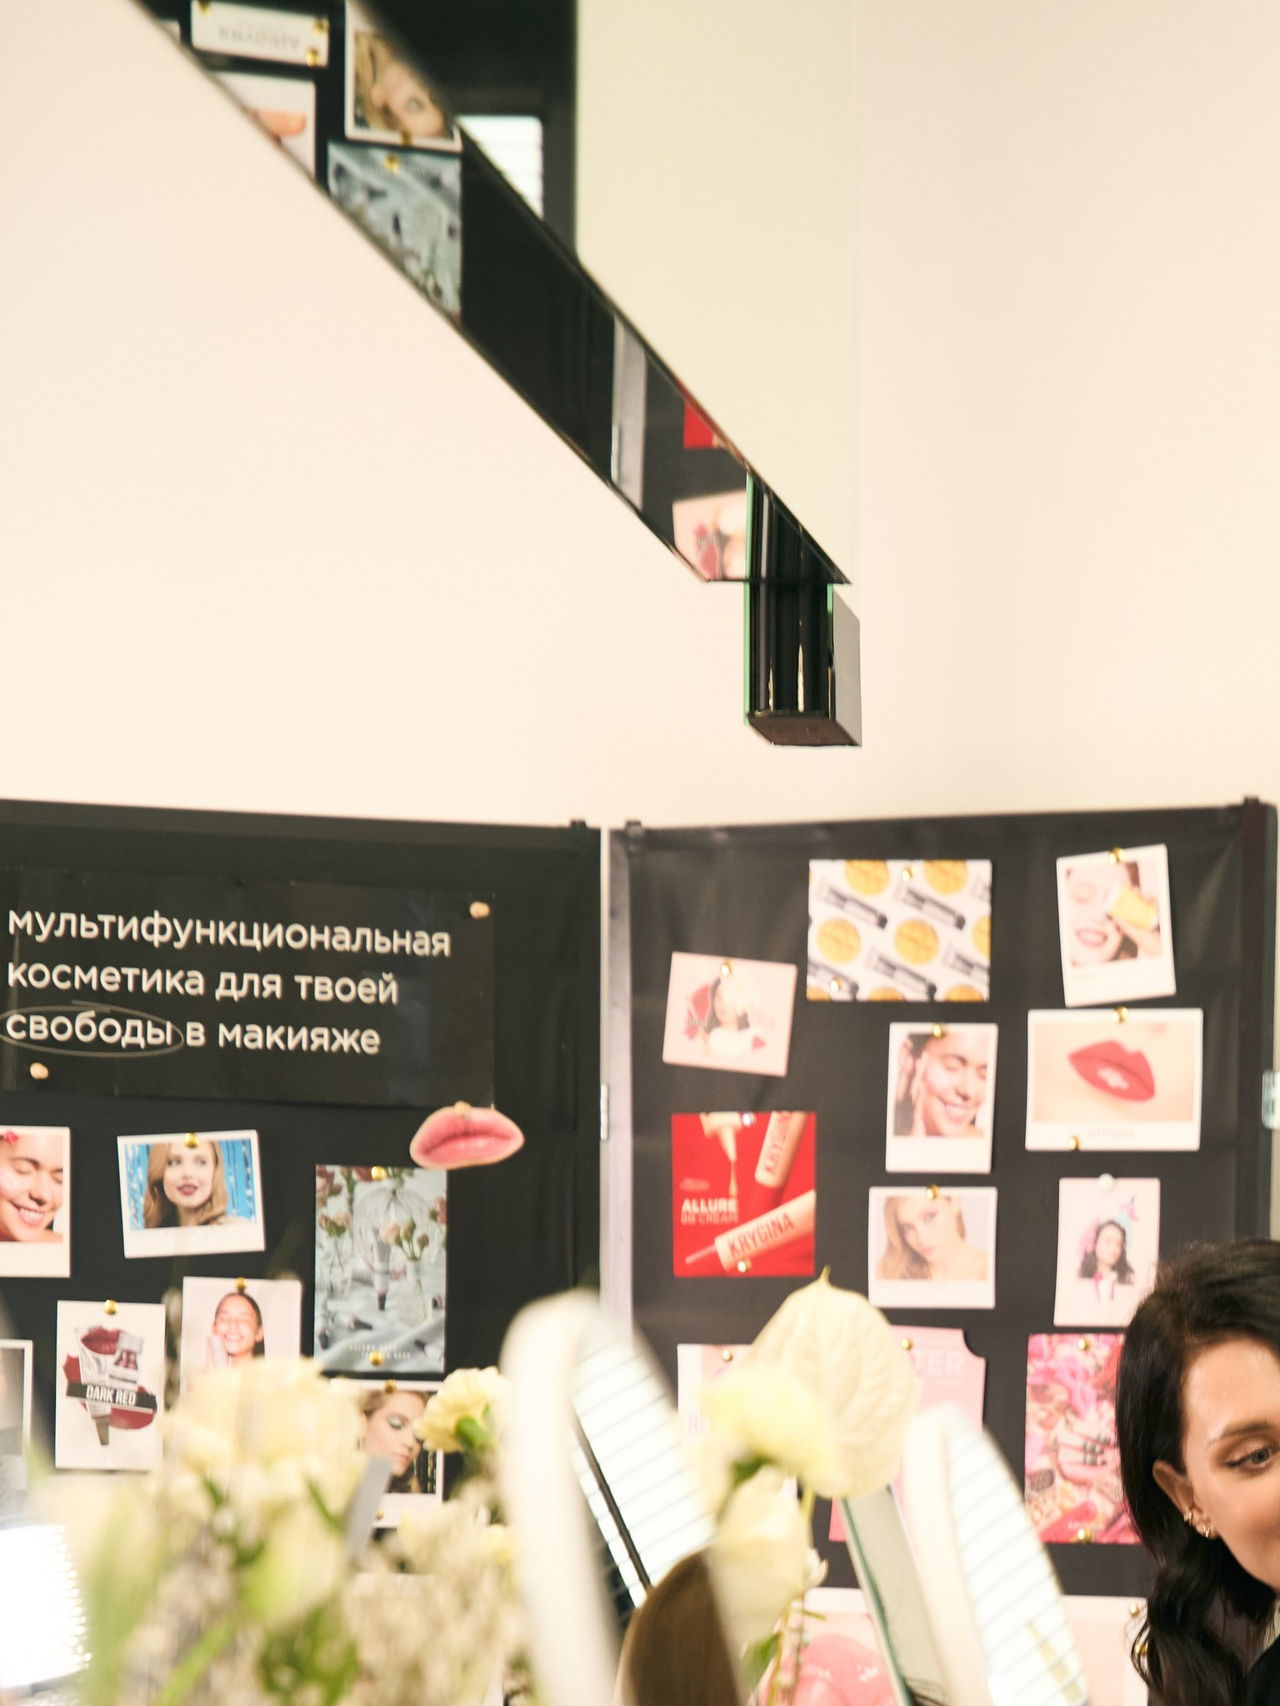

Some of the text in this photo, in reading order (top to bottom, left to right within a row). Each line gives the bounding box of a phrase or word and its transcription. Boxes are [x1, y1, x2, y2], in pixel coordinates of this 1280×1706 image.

[8, 909, 451, 957] мультифункциональная
[7, 962, 399, 1005] косметика для твоей
[5, 1010, 381, 1055] свободы в макияже
[681, 1198, 738, 1213] ALLURE
[86, 1384, 138, 1406] DARK RED
